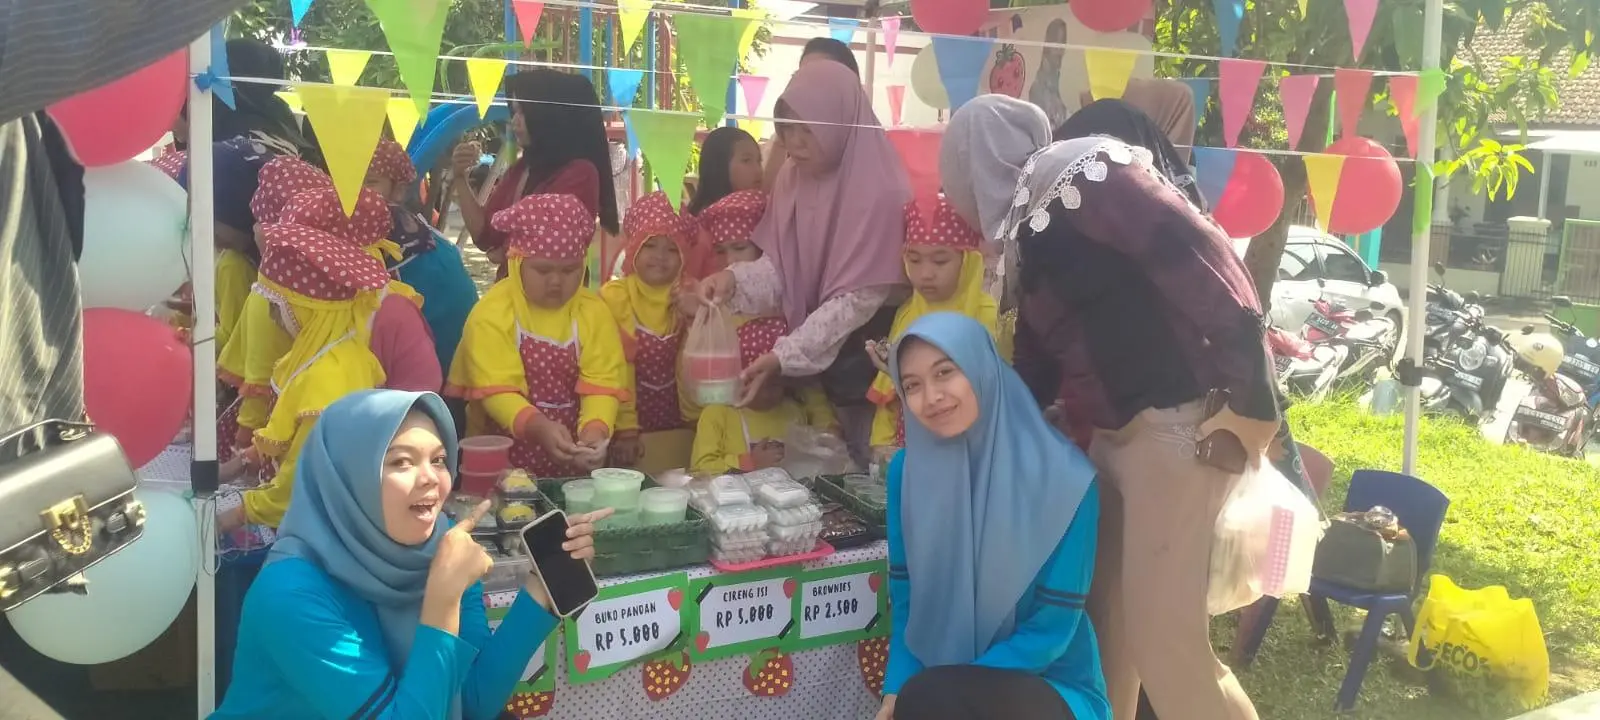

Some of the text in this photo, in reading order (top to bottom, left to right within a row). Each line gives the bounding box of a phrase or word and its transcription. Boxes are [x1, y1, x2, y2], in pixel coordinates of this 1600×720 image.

[723, 586, 768, 602] CIRENG ISI
[812, 581, 851, 597] BROWNIES
[594, 601, 656, 624] BUKO PANDAN
[716, 603, 774, 628] RP 5.000
[804, 598, 858, 622] RP 2.500
[595, 621, 659, 651] RP 5.000
